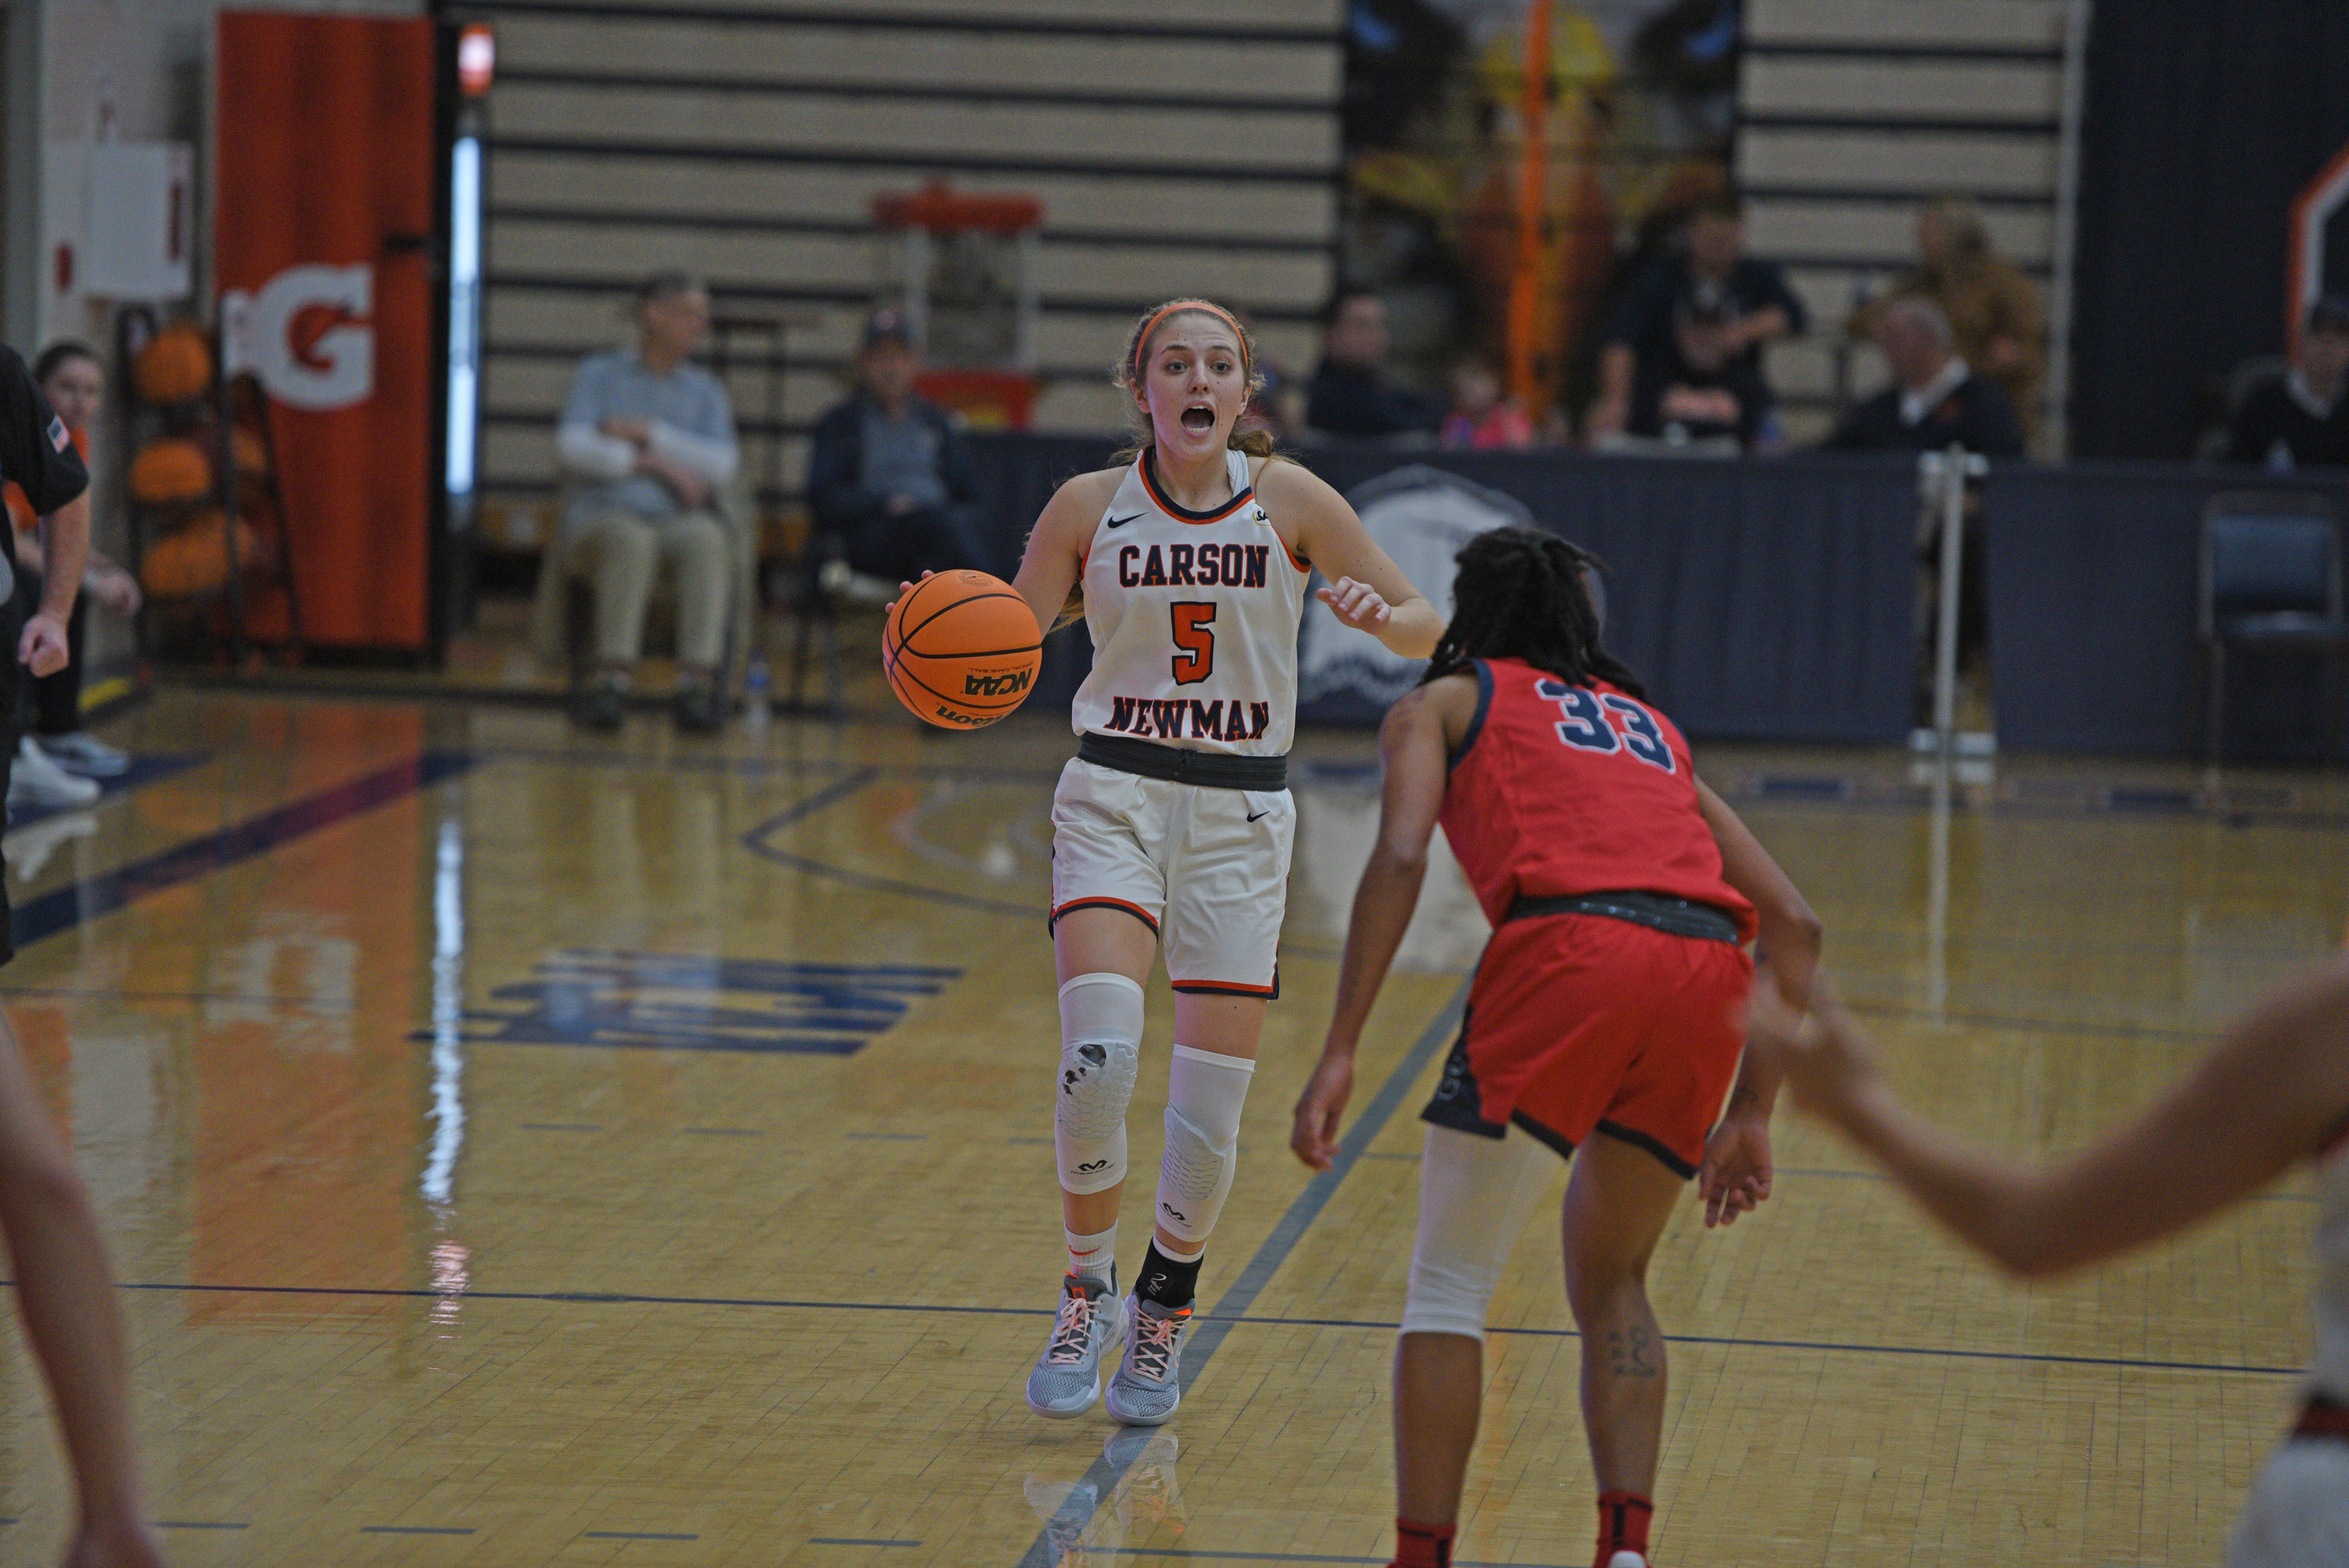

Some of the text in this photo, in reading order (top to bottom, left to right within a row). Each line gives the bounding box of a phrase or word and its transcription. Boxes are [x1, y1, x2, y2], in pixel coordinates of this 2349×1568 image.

[254, 263, 375, 413] G
[1119, 543, 1270, 588] CARSON
[1170, 601, 1217, 686] 5
[965, 667, 1033, 696] NCAA
[1103, 696, 1270, 742] NEWMAN
[1533, 678, 1677, 775] 33
